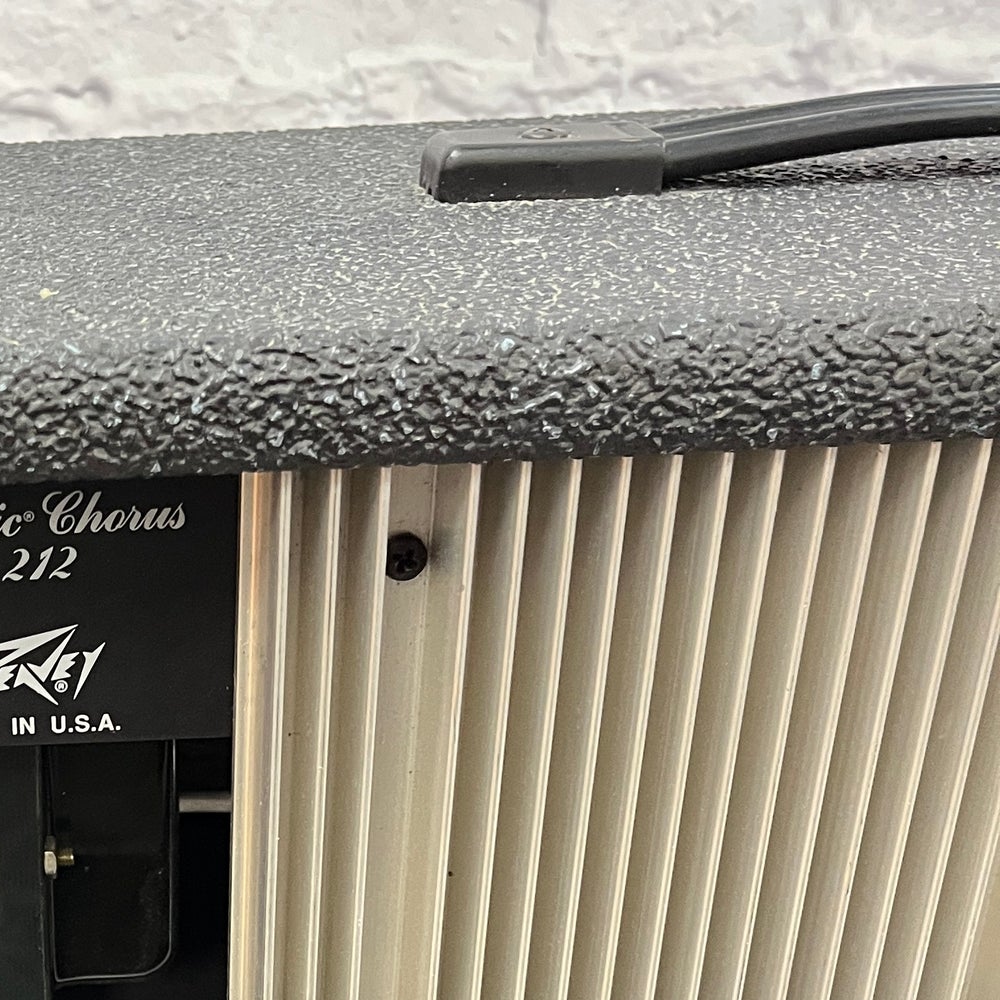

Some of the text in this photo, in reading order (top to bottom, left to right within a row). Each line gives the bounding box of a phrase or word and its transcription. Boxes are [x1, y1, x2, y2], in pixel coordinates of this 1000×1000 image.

[41, 490, 186, 535] Chorus
[1, 545, 78, 582] 212
[11, 716, 36, 736] IN
[50, 713, 122, 734] U.S.A.
